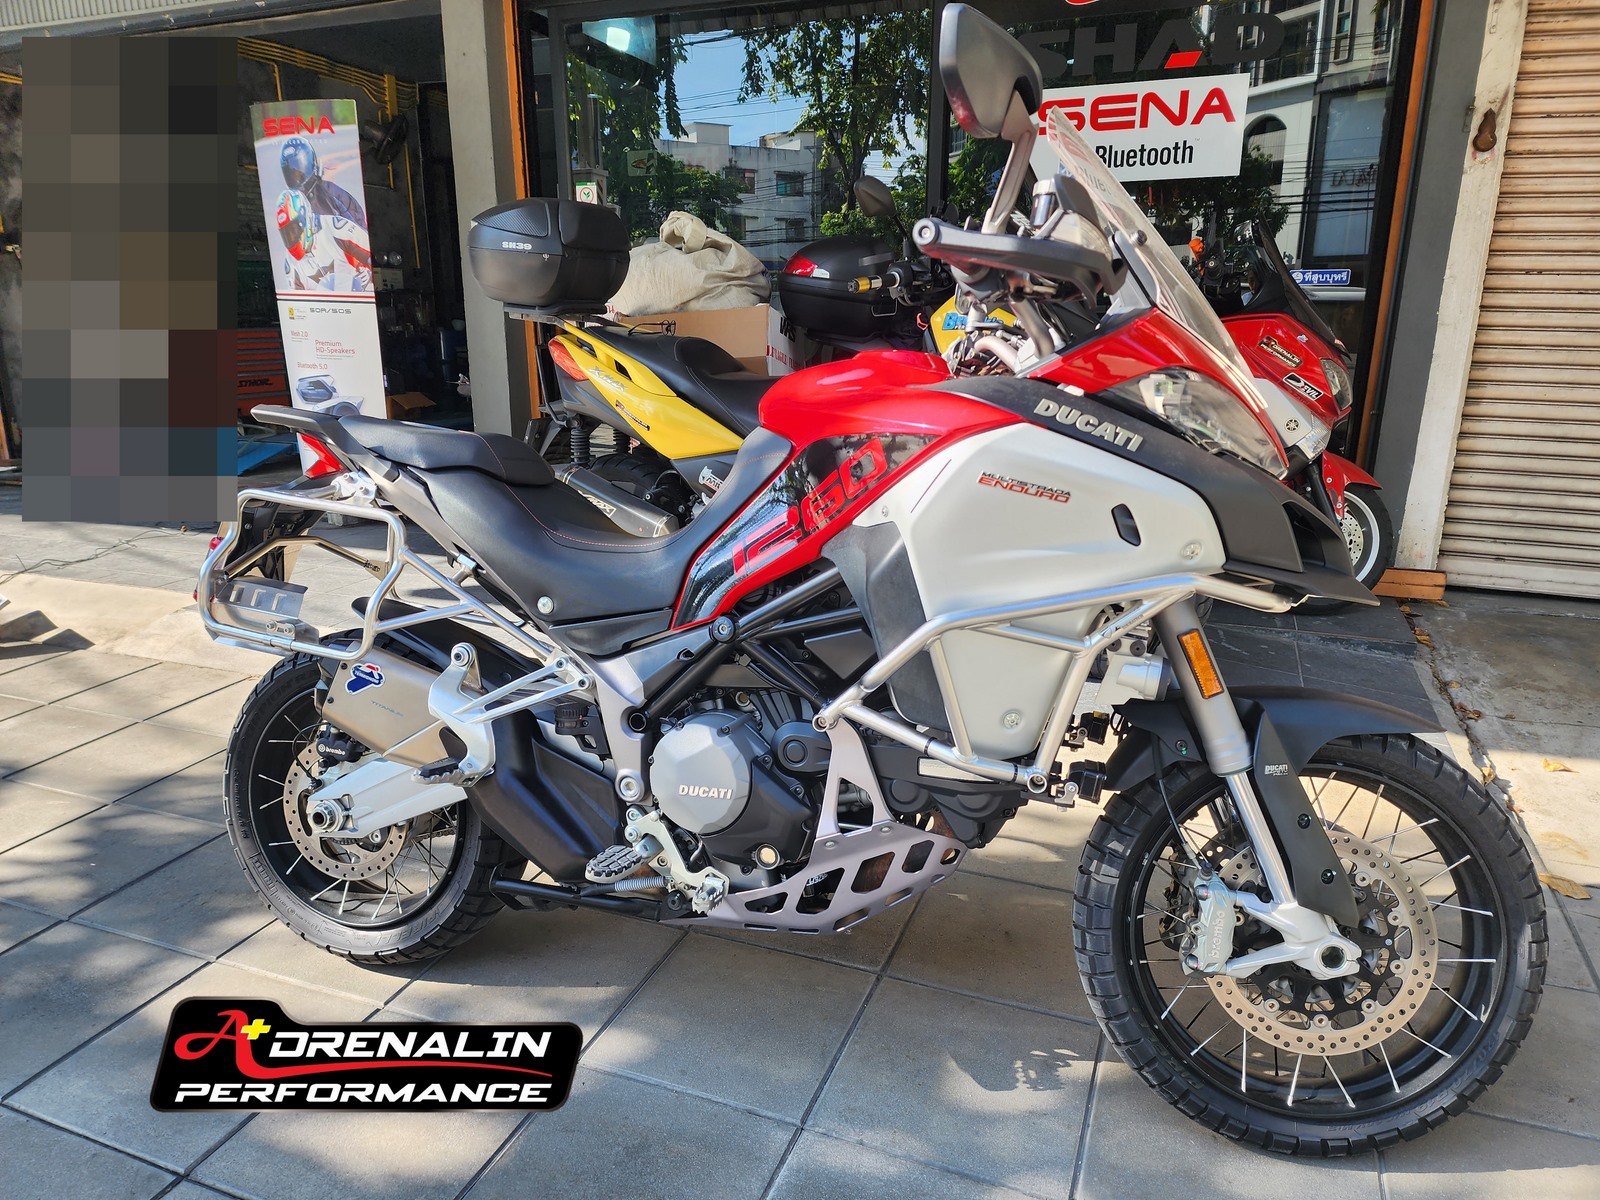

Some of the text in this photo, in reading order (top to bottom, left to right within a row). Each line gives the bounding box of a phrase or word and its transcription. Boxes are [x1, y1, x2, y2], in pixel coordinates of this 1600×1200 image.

[1016, 13, 1285, 81] SHAD
[1038, 87, 1236, 136] SENA
[262, 114, 336, 138] SENA
[1095, 140, 1194, 168] Bluetooth
[502, 241, 533, 250] SH39
[315, 347, 356, 355] HD-Speakers
[1034, 398, 1144, 452] DUCATI
[977, 477, 1072, 504] ENDURO
[981, 471, 1072, 497] MULTISTRADA
[325, 747, 346, 756] brembo
[678, 784, 733, 800] DUCATI
[1208, 909, 1226, 959] brembo
